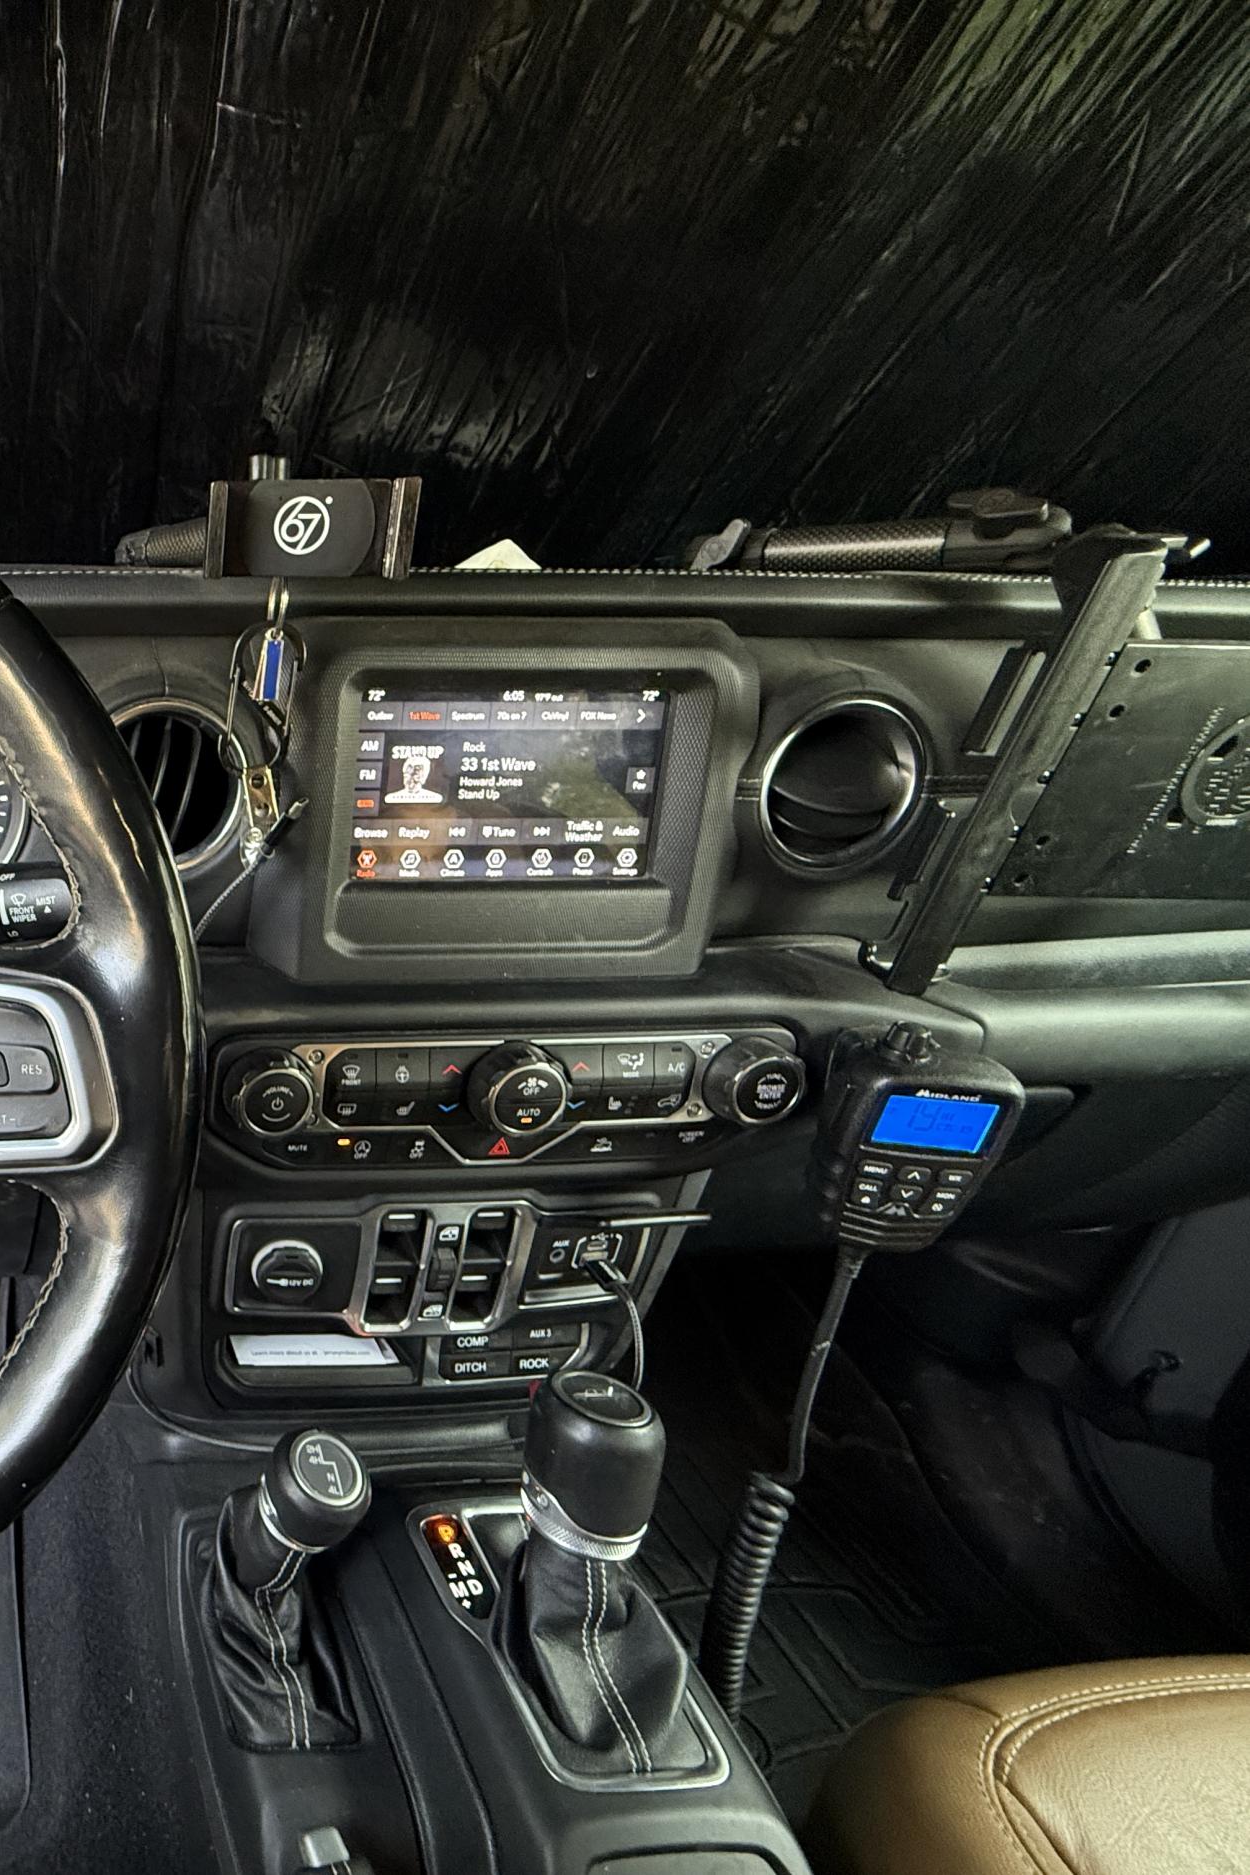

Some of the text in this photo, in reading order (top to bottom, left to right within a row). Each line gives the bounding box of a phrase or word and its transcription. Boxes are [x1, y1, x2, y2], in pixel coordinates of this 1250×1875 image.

[502, 690, 525, 702] 6:05
[409, 711, 441, 720] 1st Wave
[451, 711, 486, 722] Spectrum
[580, 711, 597, 720] FOX
[360, 740, 380, 752] AM
[427, 745, 445, 759] UP
[462, 741, 487, 753] Rock
[460, 757, 537, 772] 33 1st Wave
[359, 769, 377, 781] FM
[459, 776, 523, 787] Howard Jones
[458, 788, 501, 801] Stand Up
[493, 826, 516, 838] Tune
[566, 820, 595, 832] Traffic
[612, 825, 640, 837] Audio
[353, 827, 389, 839] Browse
[398, 827, 431, 839] Replay
[564, 831, 603, 843] Weather
[0, 872, 16, 881] OFF
[35, 895, 56, 905] MIST
[9, 906, 34, 915] FRONT
[11, 914, 37, 923] WIPER
[21, 1063, 42, 1075] RES
[667, 1061, 686, 1073] A/C
[622, 1071, 640, 1079] MODE
[522, 1087, 541, 1096] OFF
[756, 1084, 786, 1093] BROWSE
[915, 1089, 980, 1102] MIDLAND
[516, 1108, 541, 1118] AUTO
[287, 1144, 308, 1152] MUTE
[354, 1152, 368, 1160] OFF
[409, 1151, 424, 1159] OFF
[863, 1165, 889, 1175] MENU
[858, 1183, 878, 1192] CALL
[935, 1191, 956, 1200] MON
[552, 1239, 570, 1248] AUX
[529, 1328, 546, 1338] AUX
[456, 1336, 489, 1348] COMP
[454, 1362, 487, 1374] DITCH
[519, 1358, 550, 1370] ROCK
[448, 1542, 466, 1559] R
[456, 1559, 476, 1577] N
[449, 1579, 484, 1598] M D
